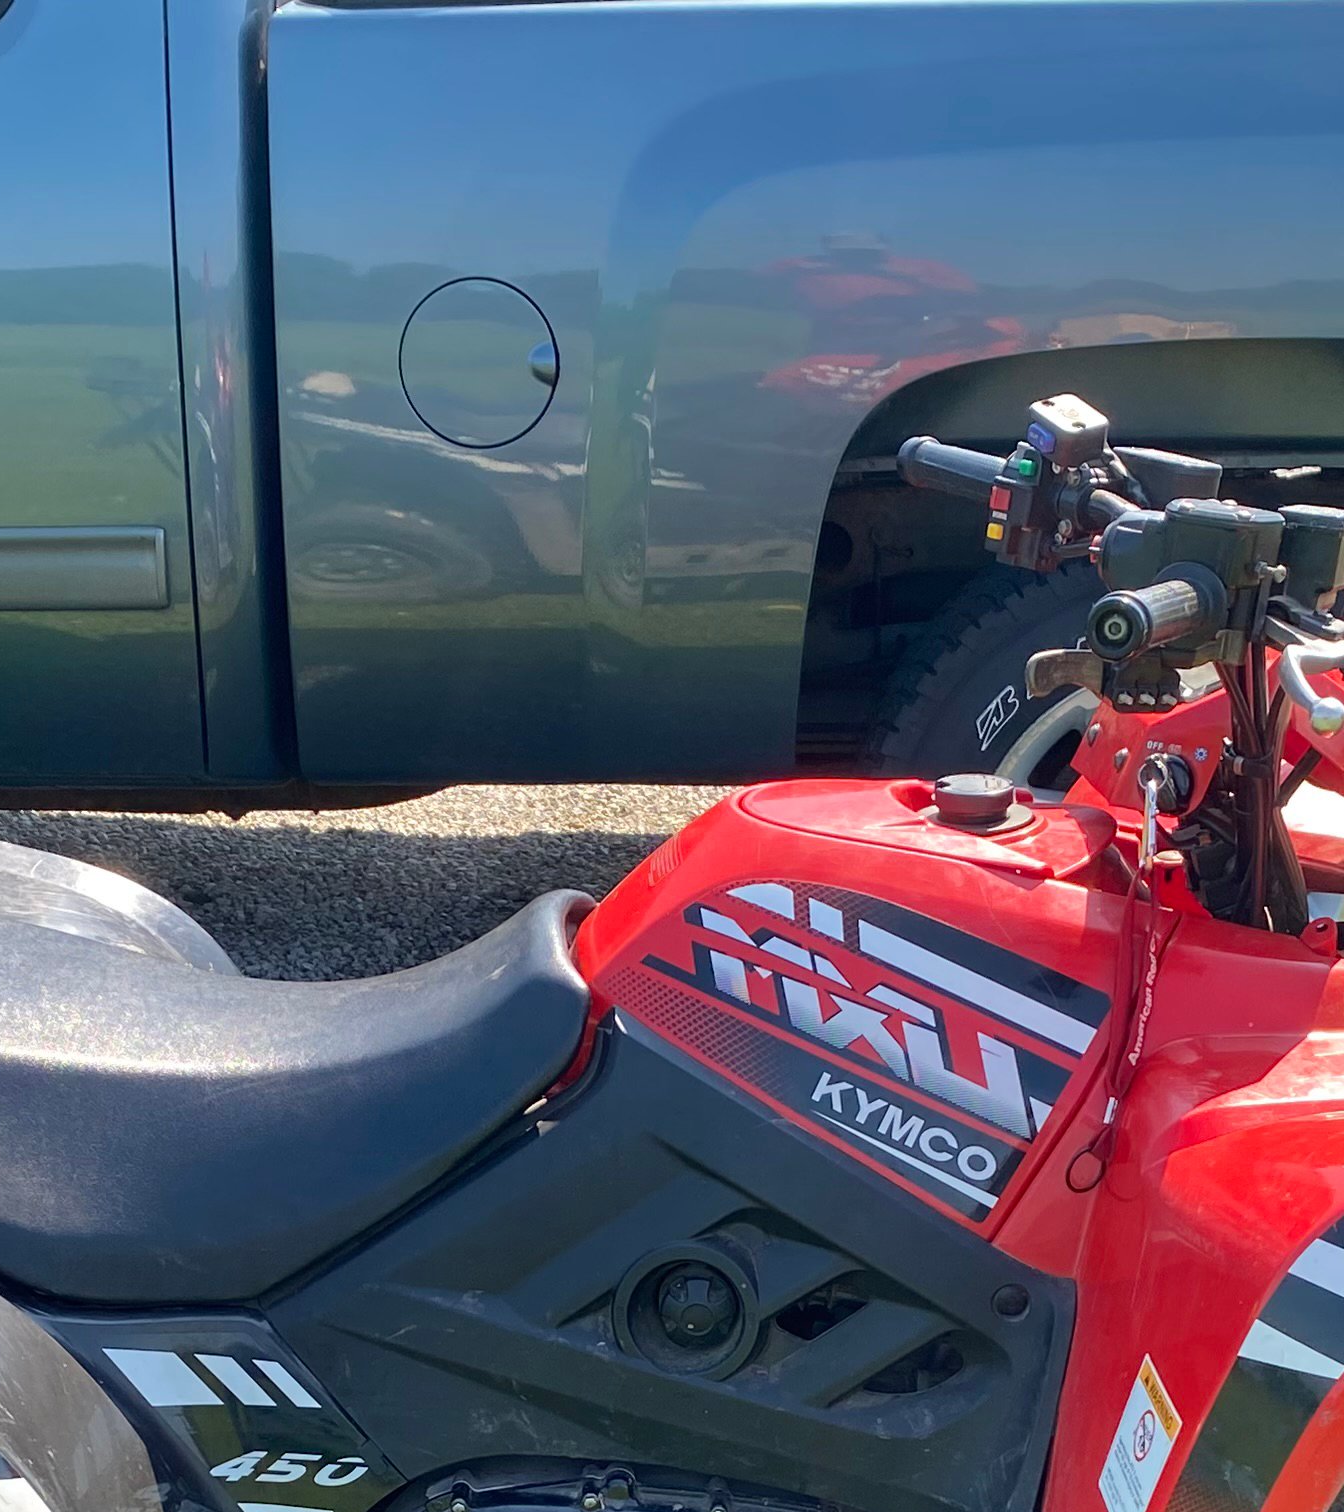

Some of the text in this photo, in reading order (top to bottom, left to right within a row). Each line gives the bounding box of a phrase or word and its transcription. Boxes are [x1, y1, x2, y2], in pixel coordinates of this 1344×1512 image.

[1146, 740, 1164, 751] OFF
[1127, 986, 1153, 1066] American
[1145, 952, 1157, 986] Red
[810, 1070, 998, 1182] KYMCO
[208, 1450, 369, 1487] 450
